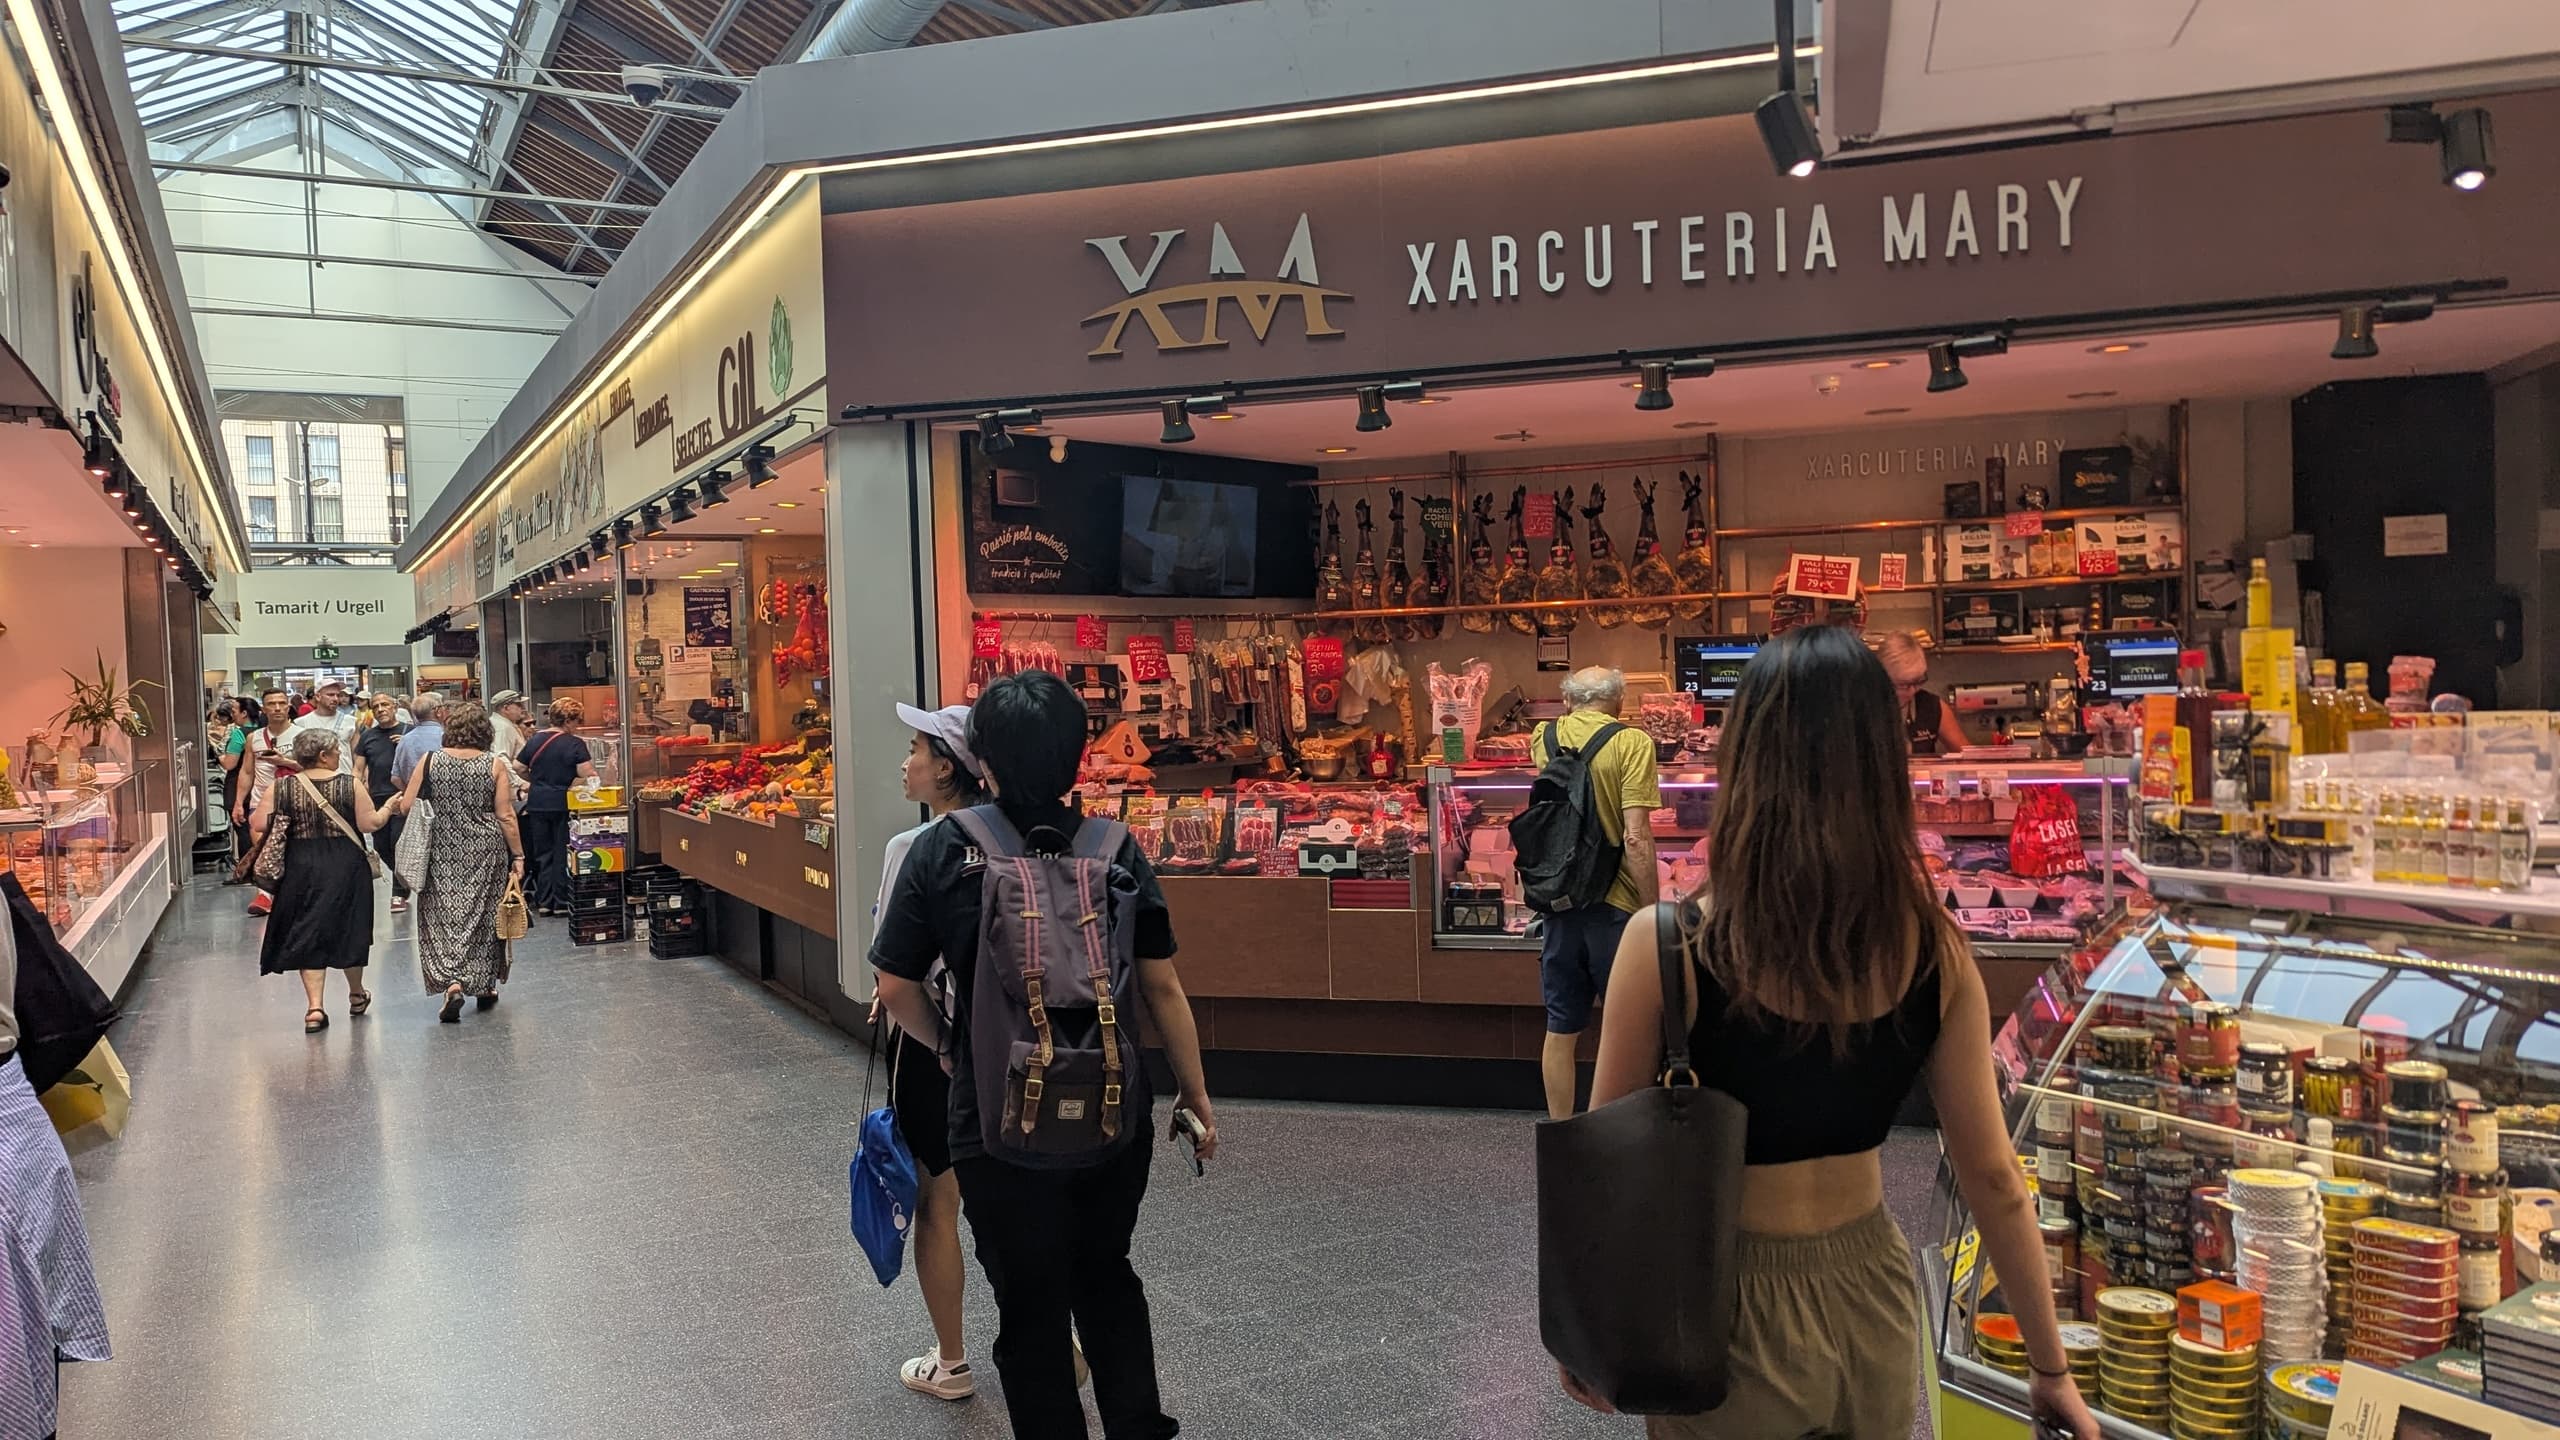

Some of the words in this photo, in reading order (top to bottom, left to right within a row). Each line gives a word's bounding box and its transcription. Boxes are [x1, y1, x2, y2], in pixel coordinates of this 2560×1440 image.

[1406, 203, 1838, 306] XARCUTERIA
[1882, 177, 2084, 262] MARY
[675, 417, 713, 466] SELECTES
[1807, 446, 1977, 480] XARCUTERIA
[1992, 439, 2066, 467] MARY
[1035, 531, 1069, 561] embotits
[255, 601, 319, 615] Tamarit
[336, 600, 385, 616] Urgell
[1177, 634, 1192, 648] 38
[1136, 660, 1157, 679] 45
[1685, 682, 1698, 692] 23
[2091, 681, 2107, 691] 23
